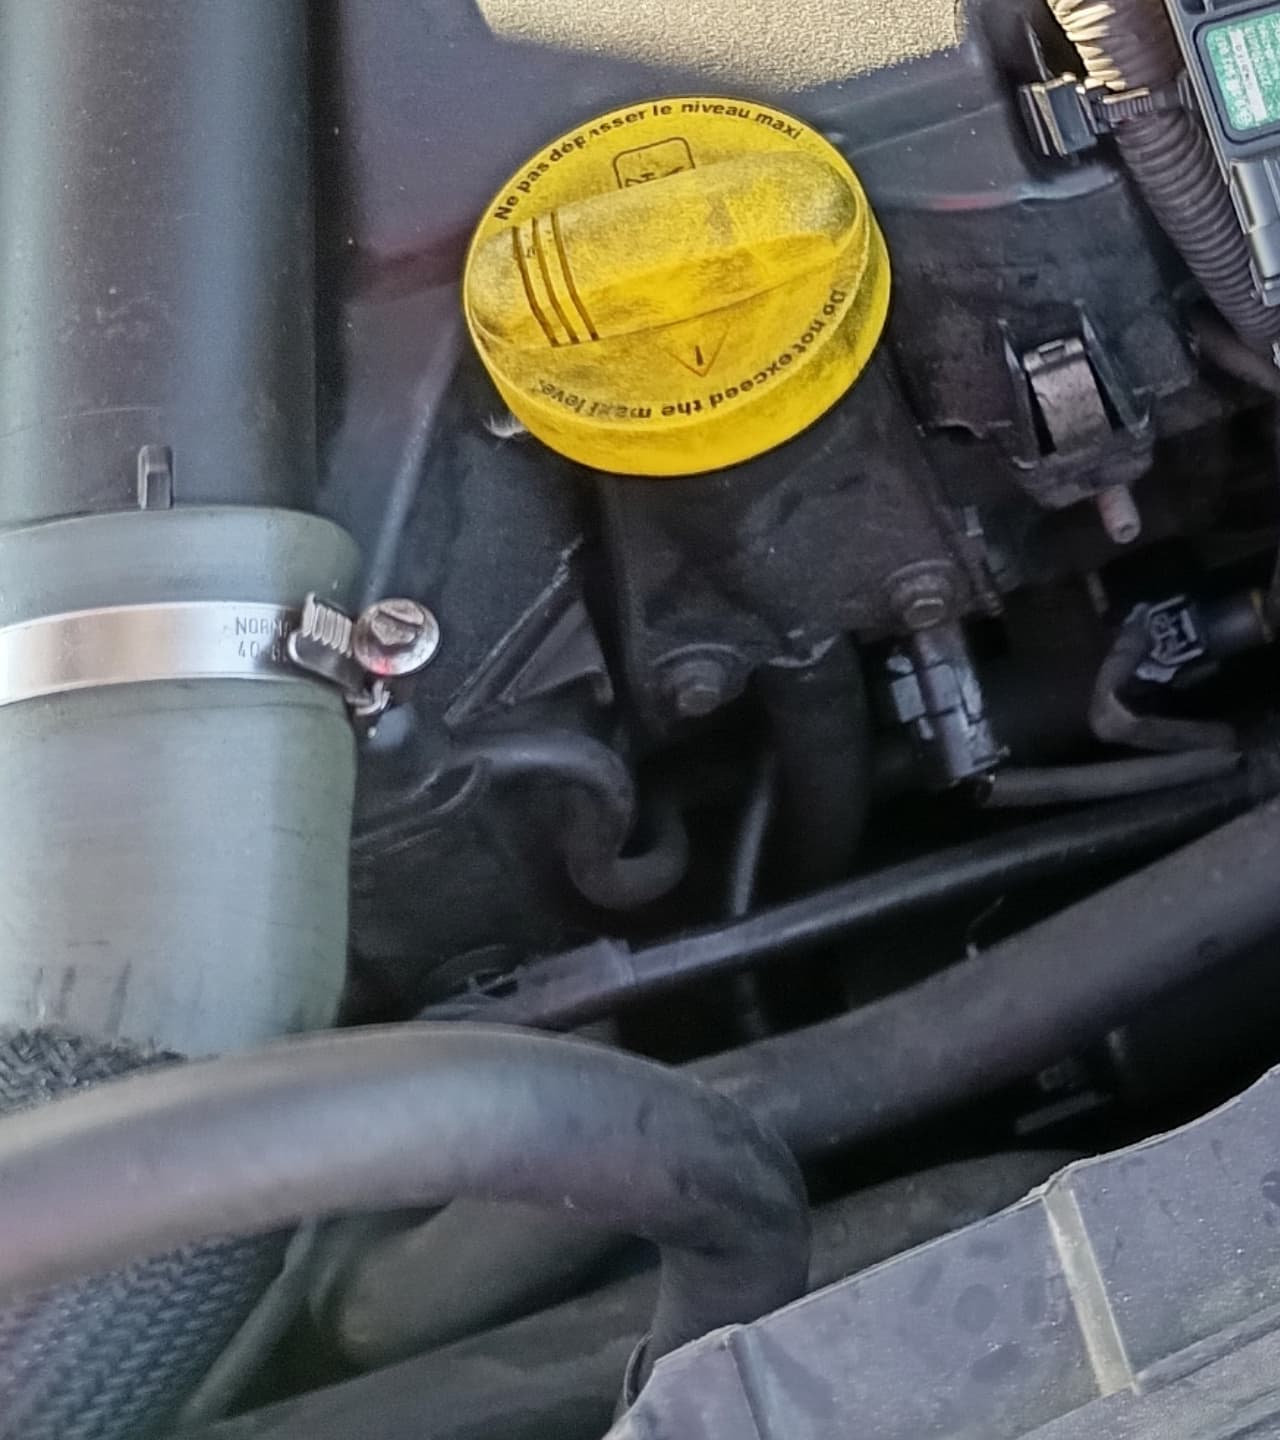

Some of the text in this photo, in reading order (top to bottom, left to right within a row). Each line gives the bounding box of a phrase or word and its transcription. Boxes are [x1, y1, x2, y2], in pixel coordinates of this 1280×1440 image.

[494, 193, 520, 221] Ne
[518, 160, 550, 195] pas
[652, 103, 674, 117] le
[680, 101, 752, 121] niveau
[754, 112, 803, 141] maxi
[823, 289, 848, 317] Do
[794, 318, 826, 356] not
[709, 353, 795, 408] exceed
[661, 400, 703, 419] the
